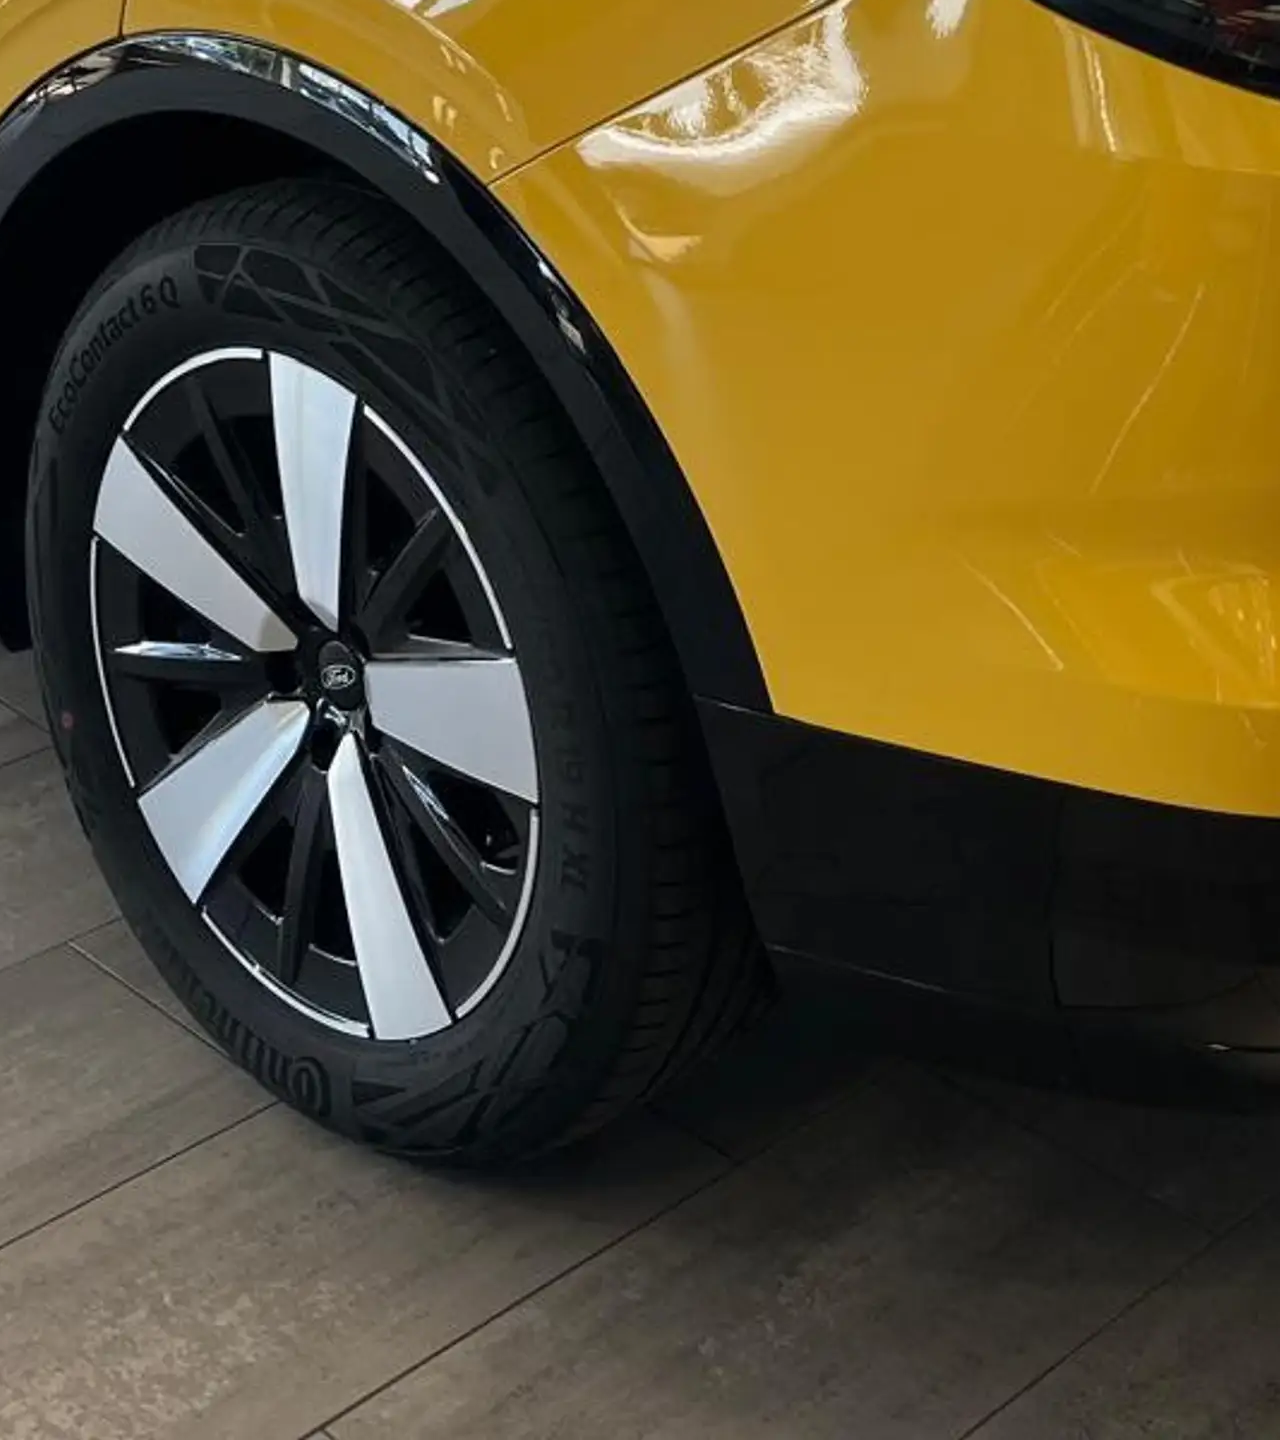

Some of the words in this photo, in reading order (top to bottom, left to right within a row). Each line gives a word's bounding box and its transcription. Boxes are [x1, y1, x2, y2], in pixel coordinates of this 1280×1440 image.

[49, 298, 141, 435] EcoContact
[139, 283, 157, 315] 6
[159, 274, 181, 309] Q
